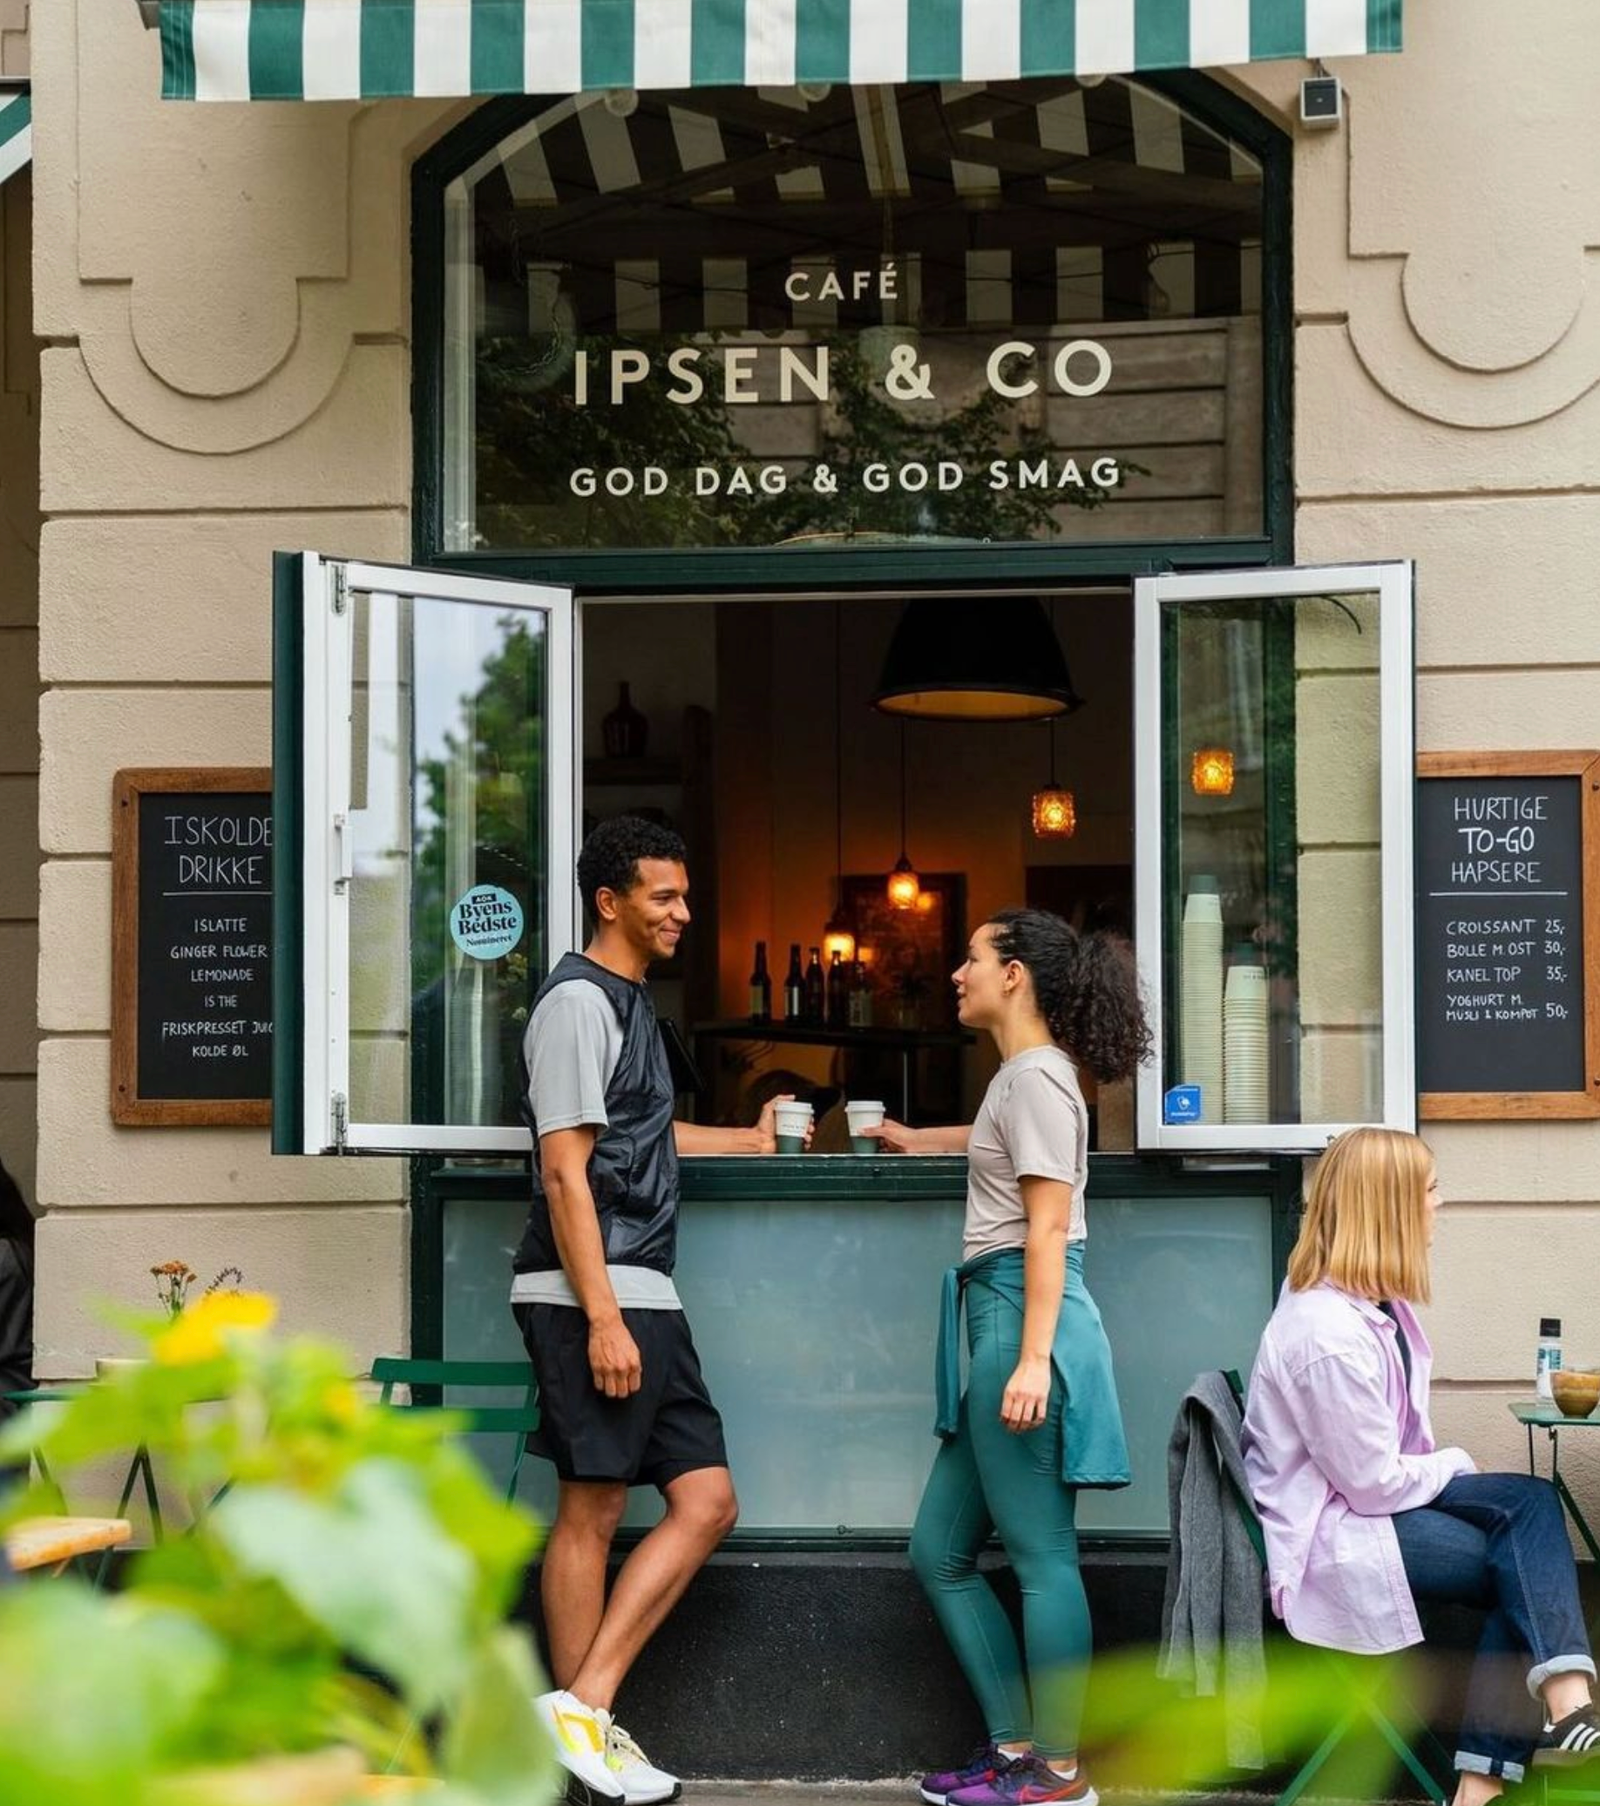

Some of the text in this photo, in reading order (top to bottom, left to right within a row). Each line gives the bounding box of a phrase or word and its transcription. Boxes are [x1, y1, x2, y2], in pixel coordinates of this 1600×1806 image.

[786, 263, 897, 300] CAFÉ
[576, 340, 1111, 404] IPSEN & CO
[571, 458, 1118, 496] GOD DAG & GOD SMAG
[1454, 796, 1549, 821] HURTIGE
[164, 815, 273, 847] ISKOLDE
[1457, 825, 1535, 855] TO-GO
[179, 854, 263, 885] DRIKKE
[1451, 859, 1541, 884] HAPSERE
[460, 901, 513, 920] Byens
[194, 917, 248, 933] ISLATTE
[458, 916, 517, 936] Bedste
[1445, 918, 1537, 936] CROISSANT
[170, 944, 268, 959] GINGER FLOWER
[1447, 943, 1487, 959] BOLLE
[1507, 941, 1536, 956] OST
[190, 968, 254, 983] LEMONADE
[1446, 968, 1491, 983] KANEL
[1493, 965, 1522, 983] TOP
[204, 994, 237, 1008] IS THE
[1446, 993, 1505, 1008] YOGHURT
[1495, 1008, 1538, 1020] KOMPOT
[161, 1019, 273, 1039] FRISKPRESSET JUIC
[192, 1044, 249, 1058] KOLDE ØL
